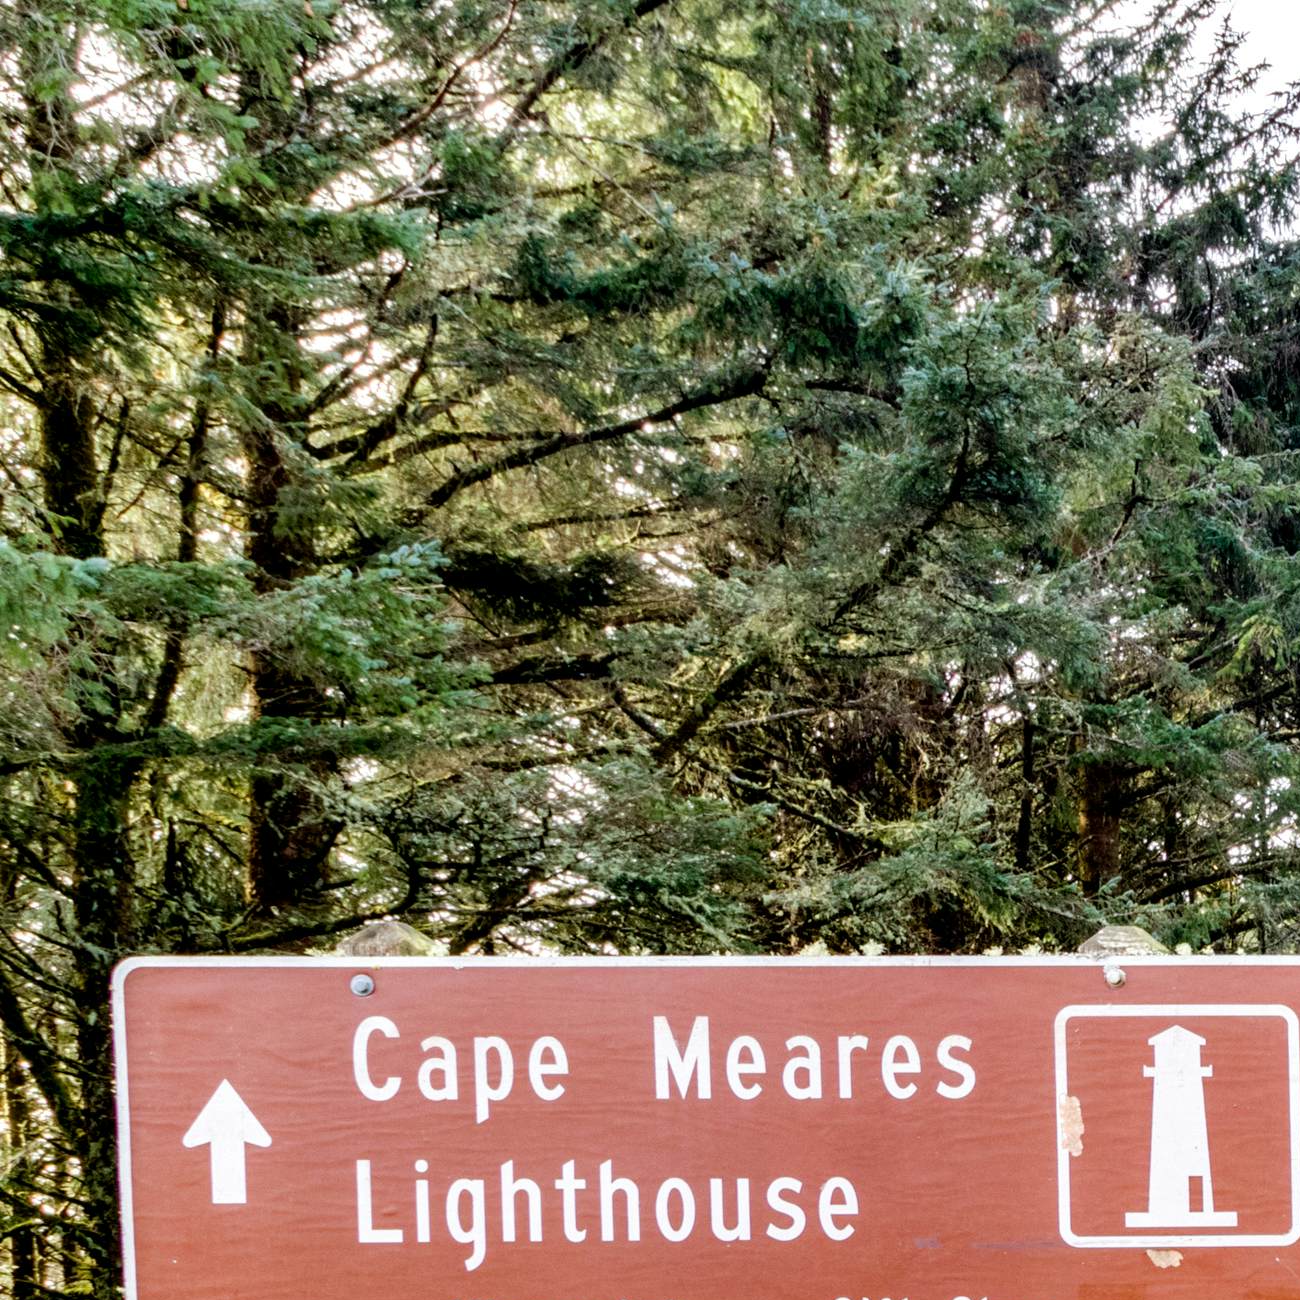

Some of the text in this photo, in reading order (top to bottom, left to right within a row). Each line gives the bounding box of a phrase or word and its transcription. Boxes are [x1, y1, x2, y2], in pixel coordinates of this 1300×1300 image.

[352, 1015, 977, 1125] Cape Meares
[355, 1158, 859, 1272] Lighthouse
